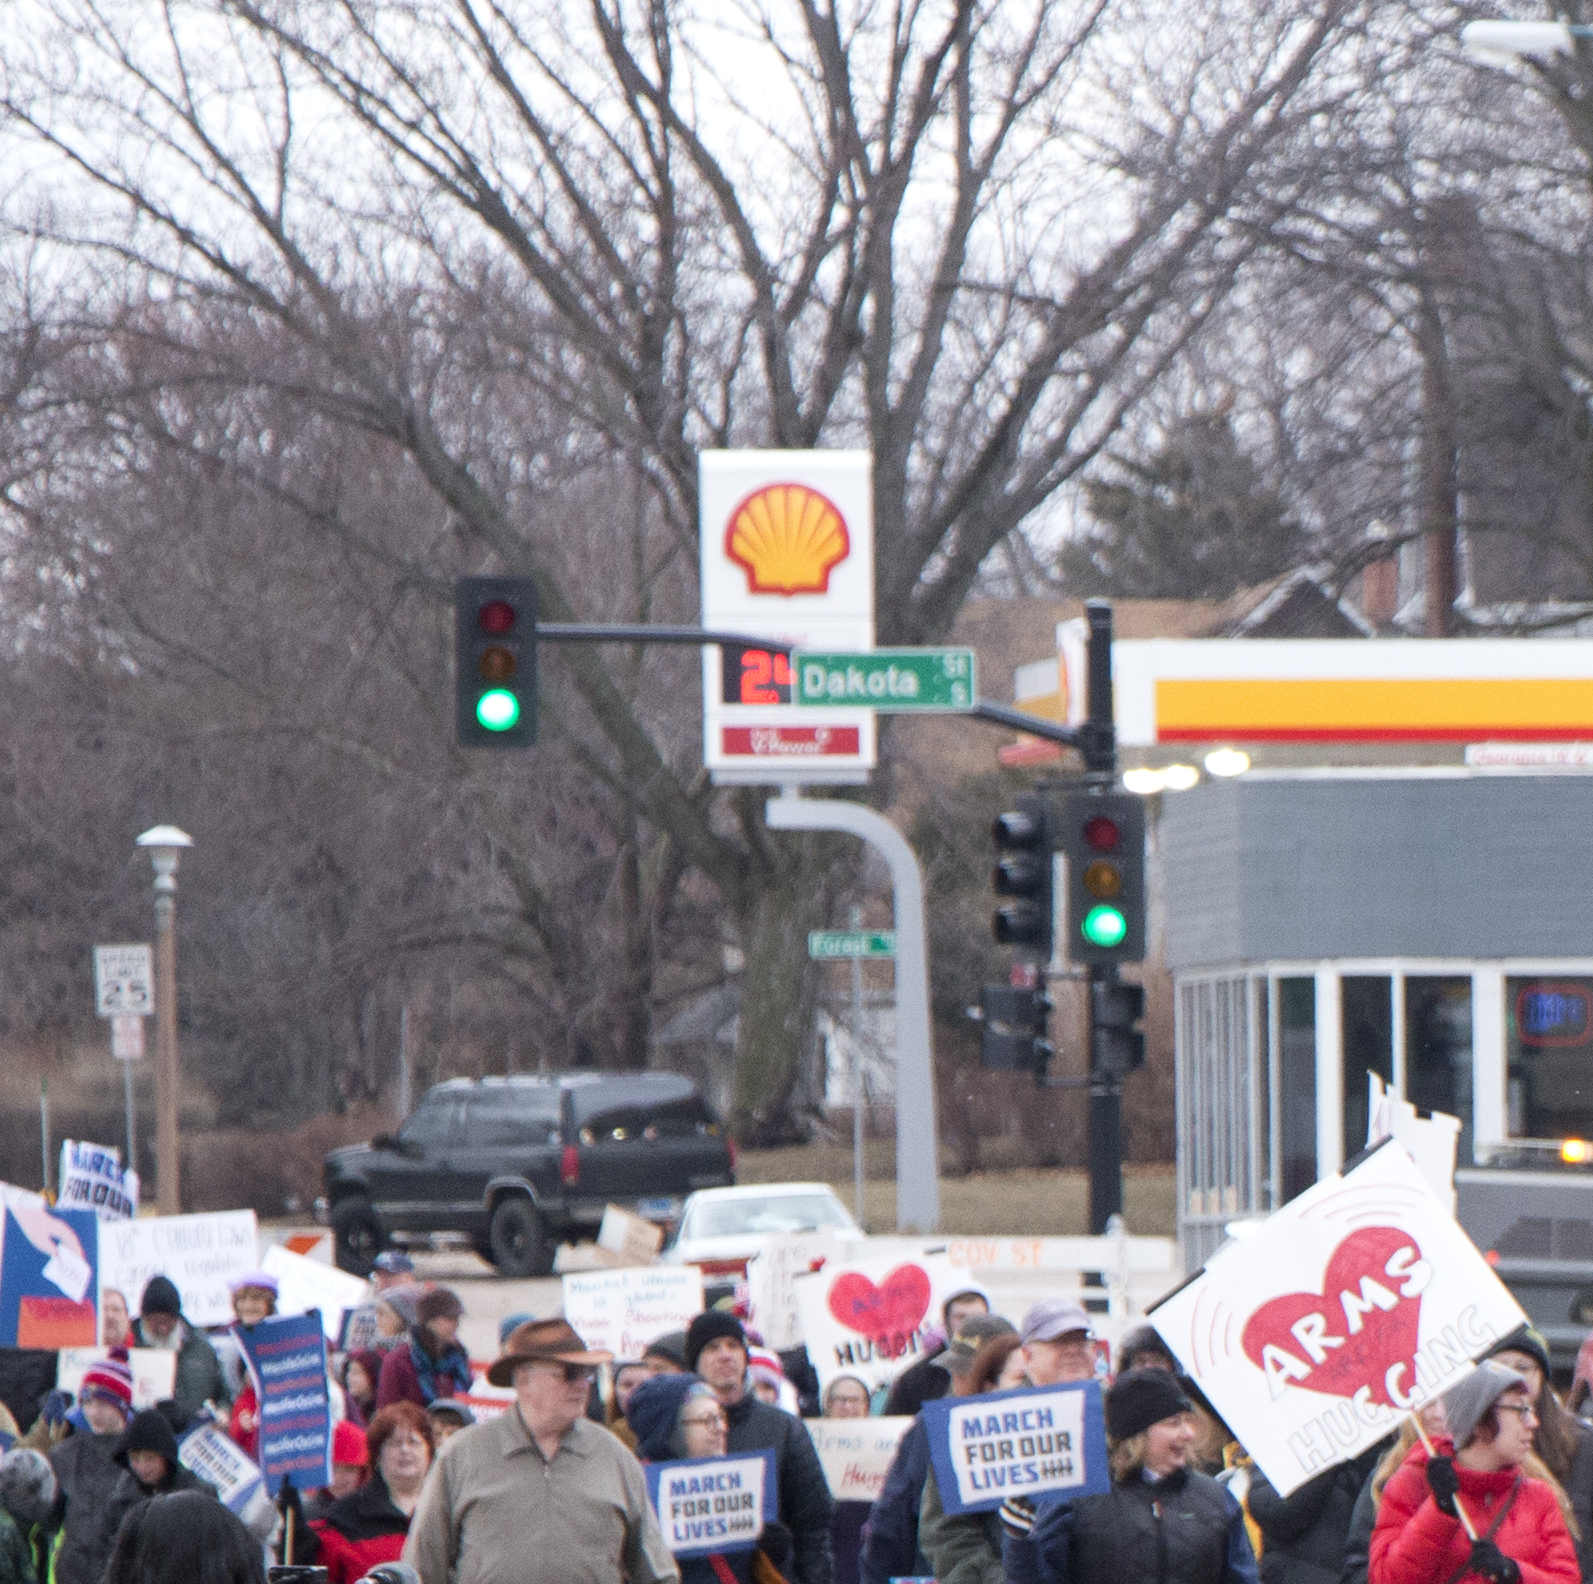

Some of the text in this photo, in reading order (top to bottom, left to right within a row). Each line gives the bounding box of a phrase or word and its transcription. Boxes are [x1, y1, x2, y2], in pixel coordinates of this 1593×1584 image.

[803, 652, 966, 698] Dakota St
[1262, 1246, 1434, 1402] ARMS
[1287, 1303, 1501, 1476] HUGGING
[962, 1407, 1053, 1439] MARCH
[964, 1431, 1072, 1465] FOR OUR
[669, 1472, 741, 1497] MARCH
[969, 1461, 1040, 1490] LIVES
[671, 1493, 754, 1519] FOR OUR
[673, 1520, 727, 1541] LIVES
